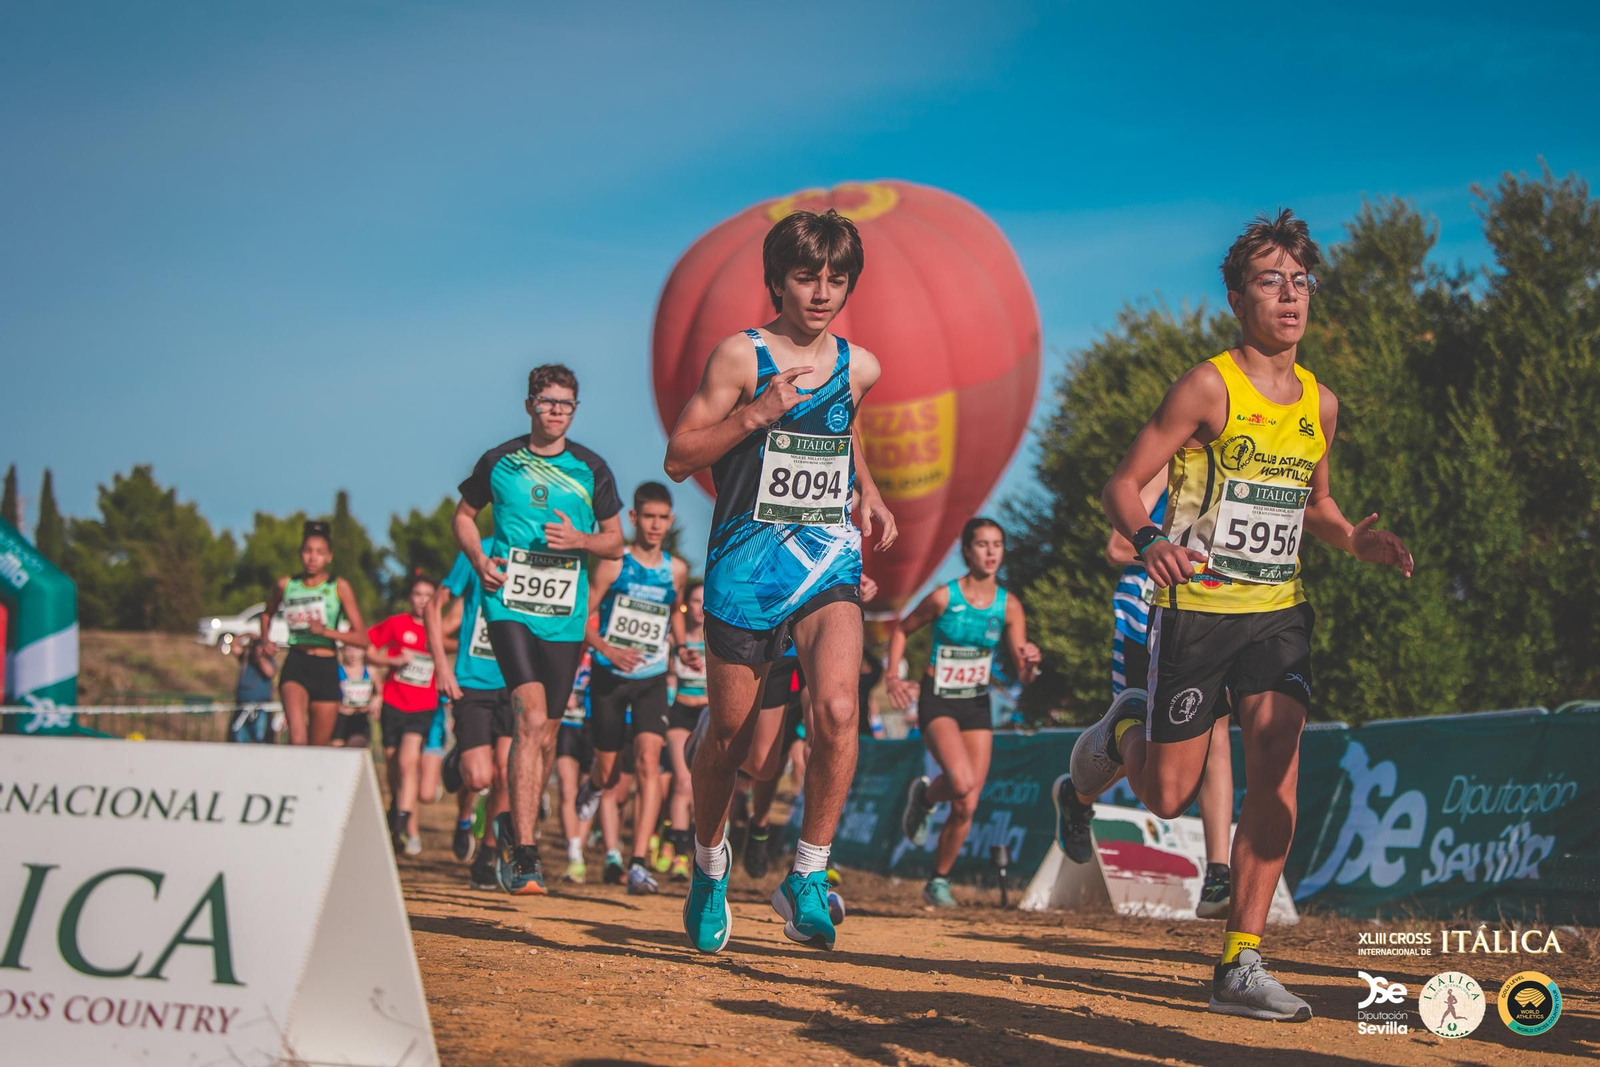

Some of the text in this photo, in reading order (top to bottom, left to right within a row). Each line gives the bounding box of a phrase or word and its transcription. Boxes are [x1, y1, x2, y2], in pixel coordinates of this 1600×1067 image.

[796, 437, 836, 451] ITÁLICA
[1254, 453, 1277, 464] CLUB
[769, 467, 841, 500] 8094
[1256, 487, 1297, 503] ITÁLICA
[1225, 518, 1298, 556] 5956
[511, 574, 572, 600] 5967
[615, 616, 661, 640] 8093
[942, 666, 986, 684] 7423
[238, 793, 298, 826] DE
[1441, 773, 1579, 823] Diputación
[1421, 821, 1556, 886] Sevilla
[62, 994, 240, 1034] COUNTRY
